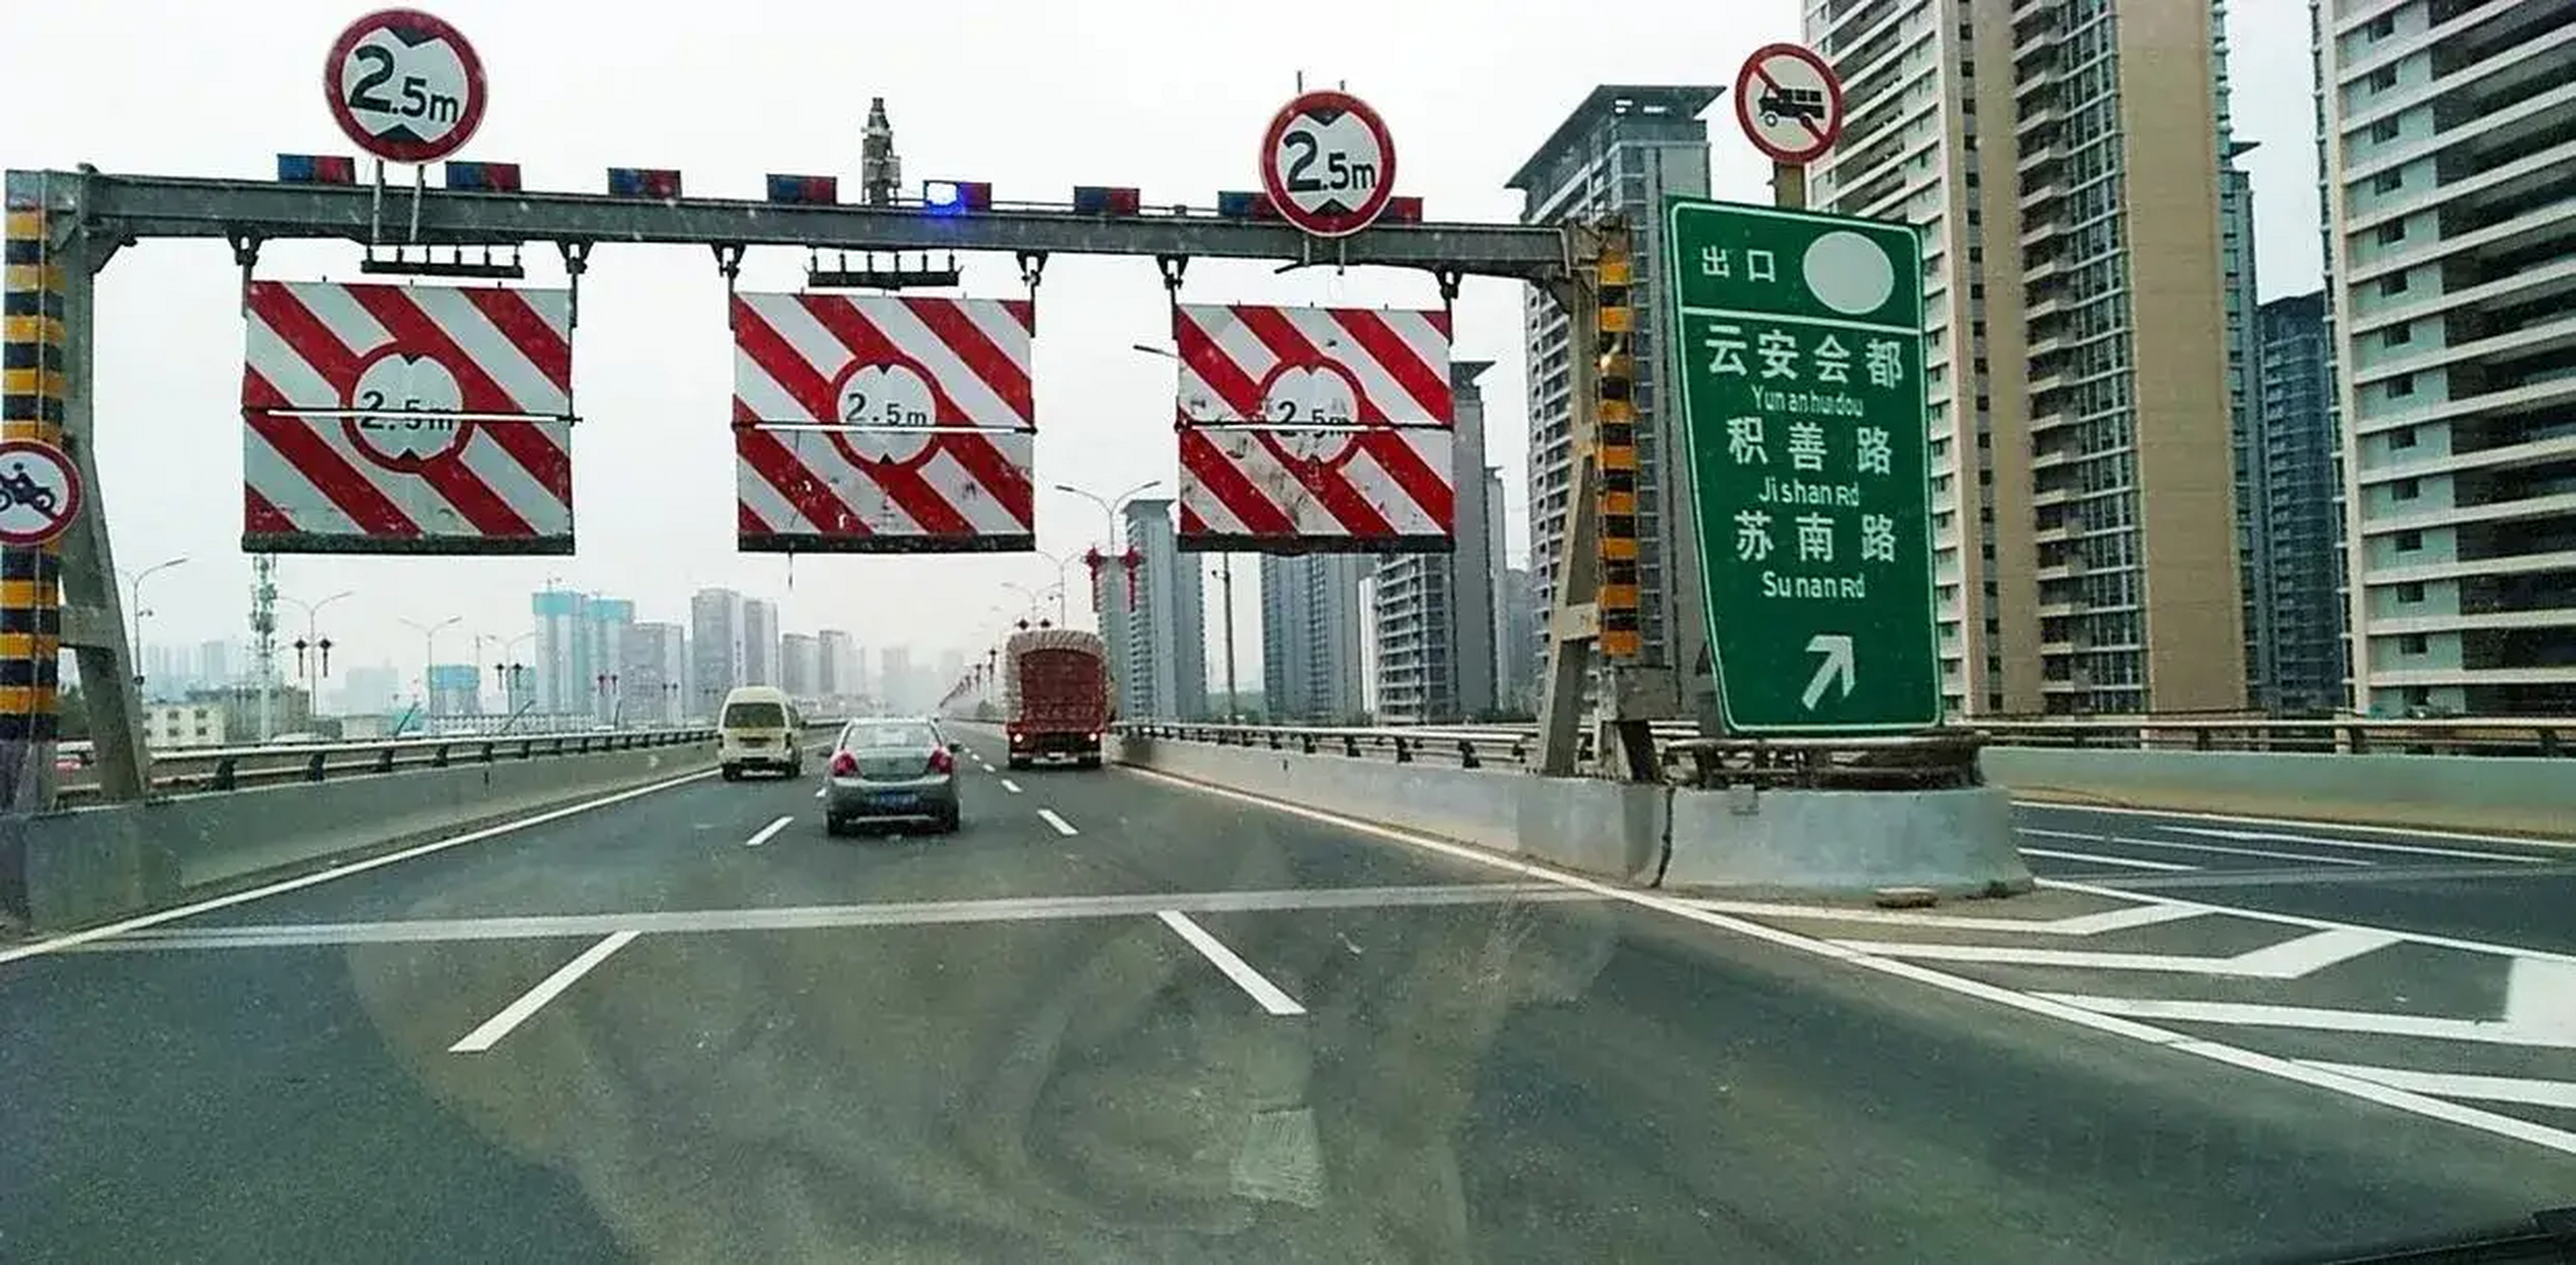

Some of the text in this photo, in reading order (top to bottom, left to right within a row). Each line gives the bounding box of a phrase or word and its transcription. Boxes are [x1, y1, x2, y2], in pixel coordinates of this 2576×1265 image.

[348, 44, 459, 124] 2.5m
[1283, 130, 1376, 193] 2.5m
[1702, 245, 1776, 283] 出口
[1705, 324, 1904, 389] 云安会都
[845, 392, 927, 426] 2.5m
[1727, 415, 1893, 475] 积善路
[1759, 475, 1859, 506] Jishan Rd
[1734, 510, 1897, 563] 苏南路
[1762, 570, 1865, 598] Sunan Rd
